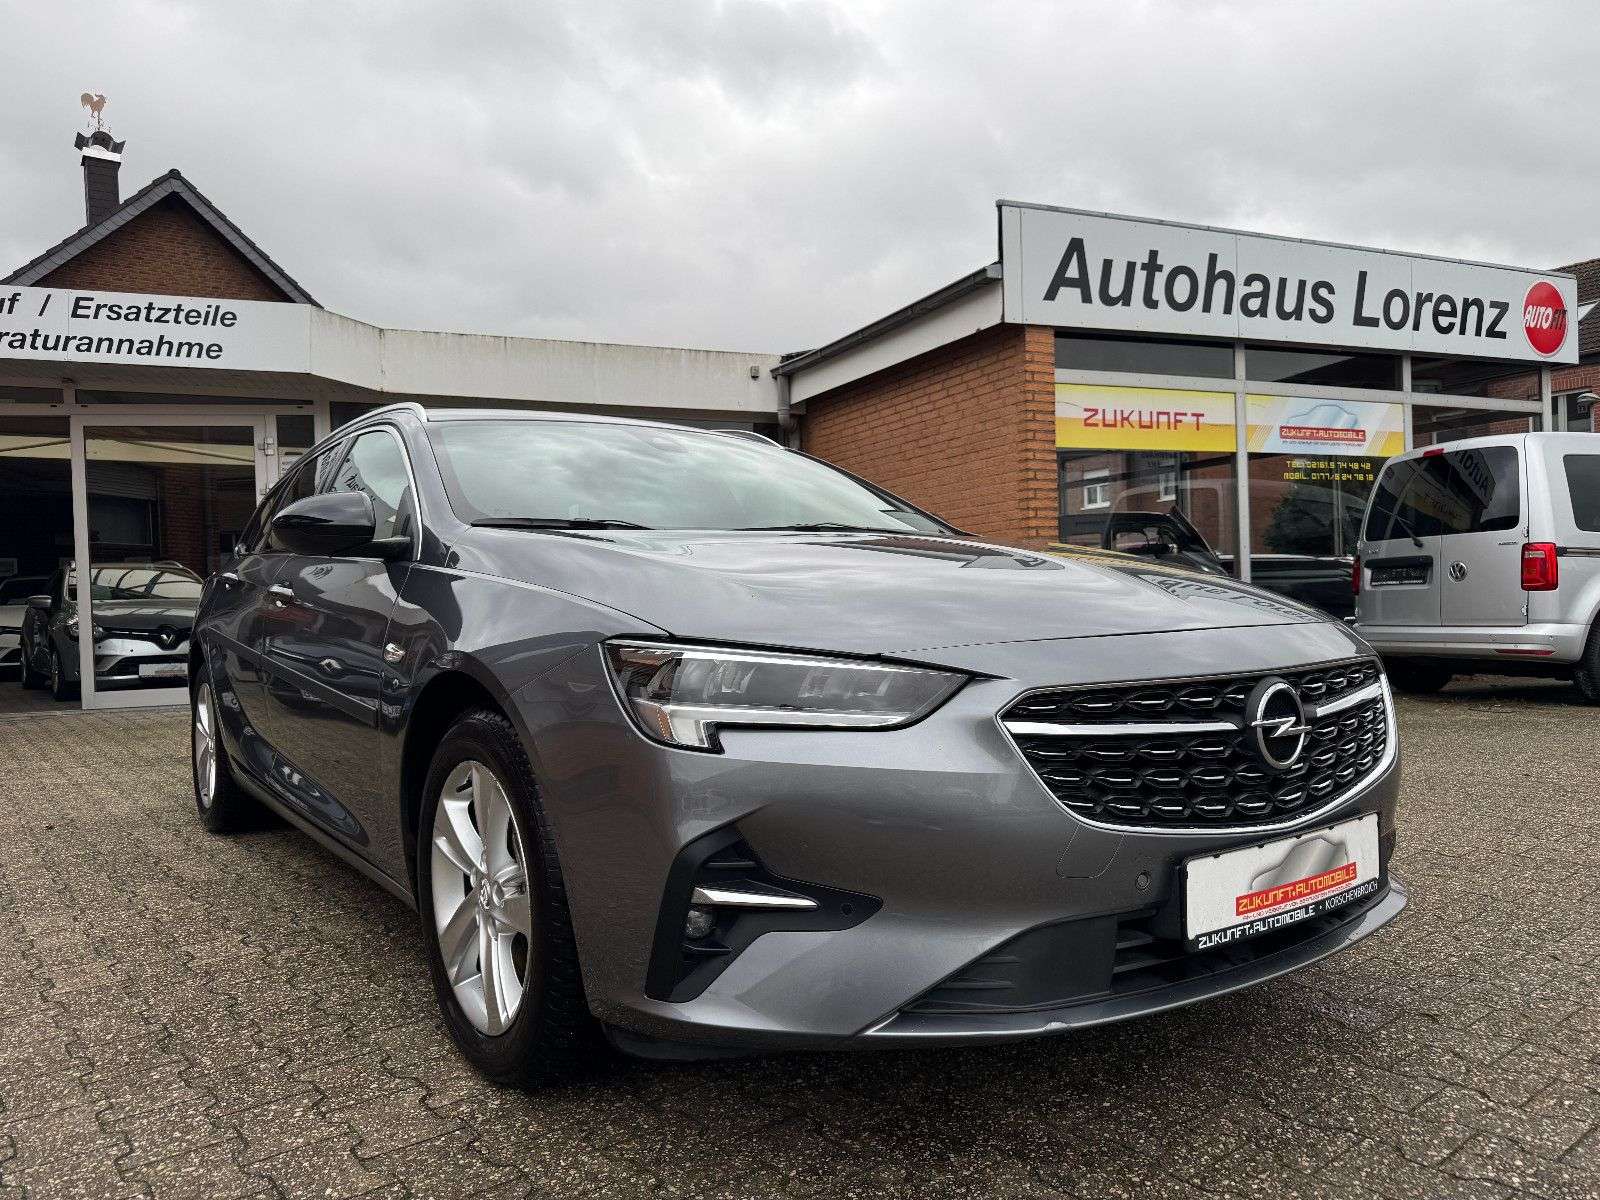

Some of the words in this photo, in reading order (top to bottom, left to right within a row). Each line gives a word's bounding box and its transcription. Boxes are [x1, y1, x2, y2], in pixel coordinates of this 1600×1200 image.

[1043, 237, 1335, 324] Autohaus
[1353, 270, 1510, 340] Lorenz
[70, 296, 238, 328] Ersatzteile
[1083, 408, 1205, 431] ZUKUNFT
